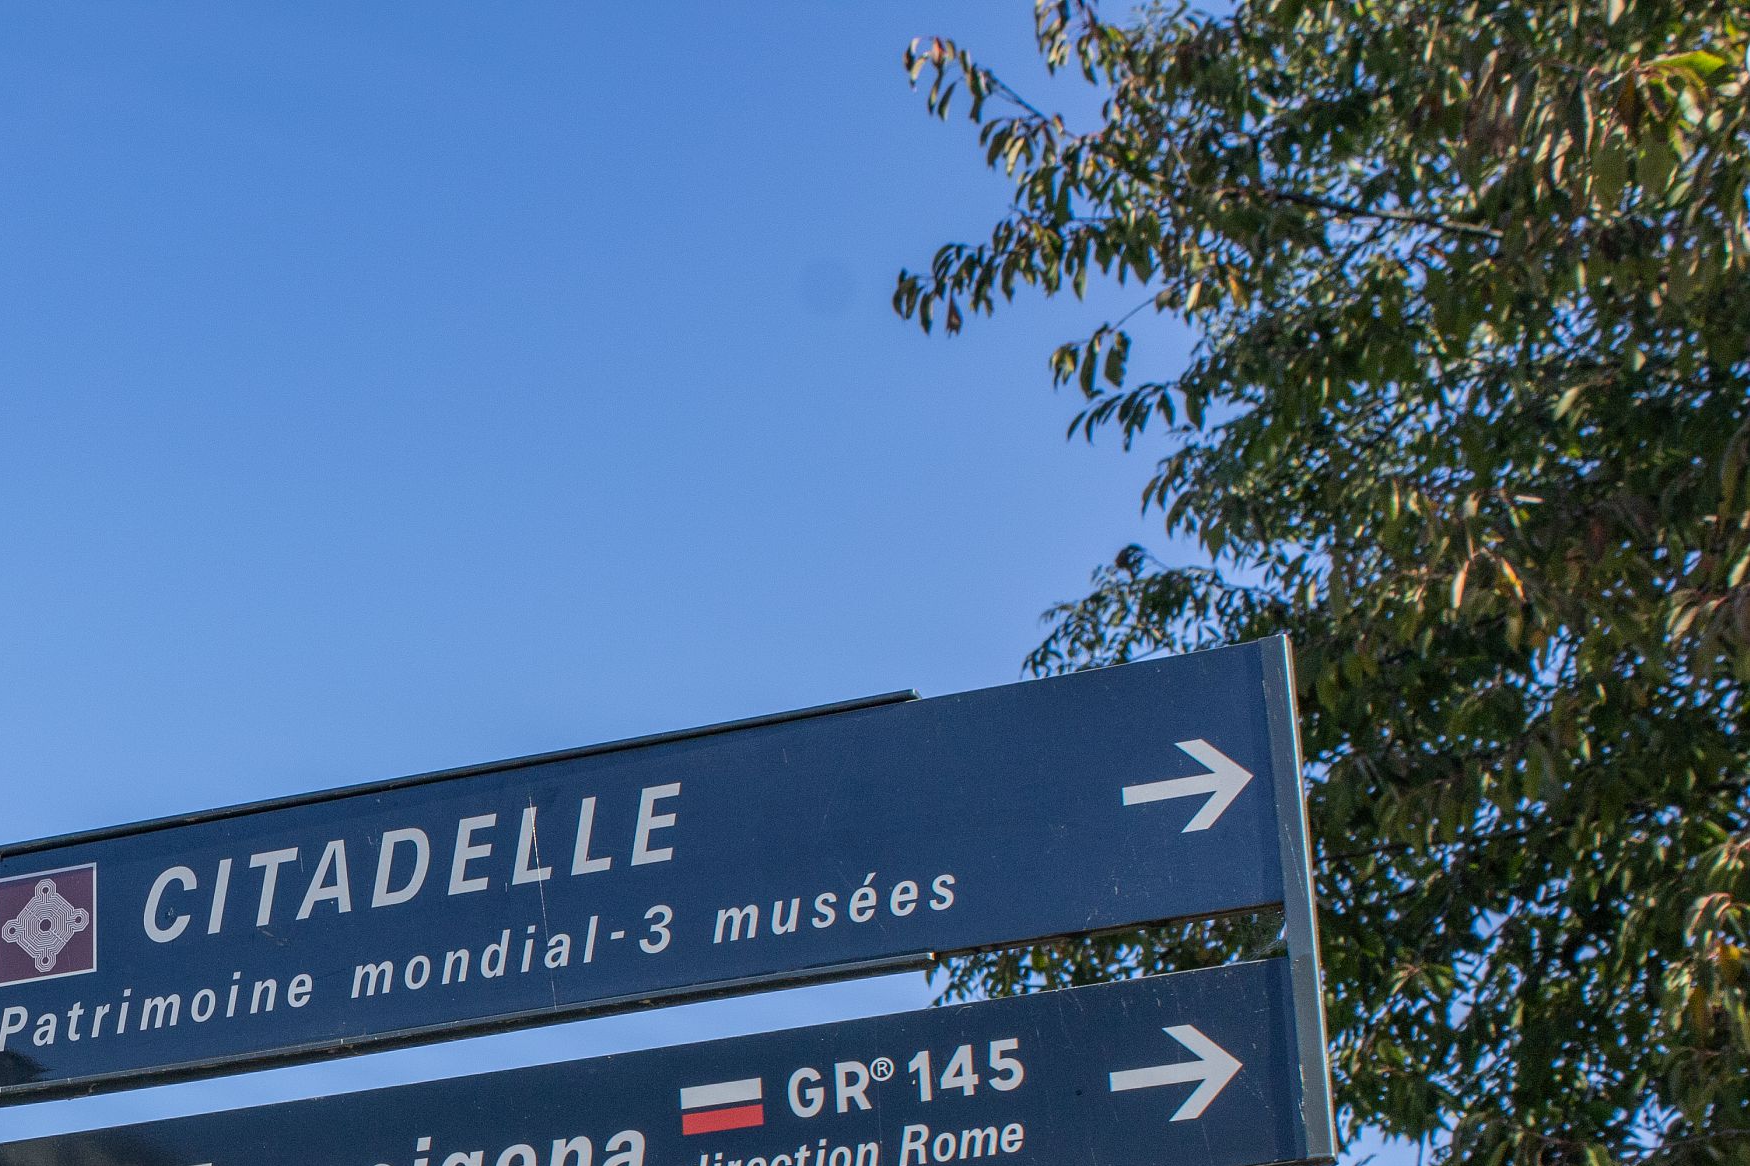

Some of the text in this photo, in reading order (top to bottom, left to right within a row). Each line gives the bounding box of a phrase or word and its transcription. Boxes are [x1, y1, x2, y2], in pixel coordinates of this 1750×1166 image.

[144, 783, 681, 943] CITADELLE
[351, 905, 672, 998] mondial-3
[714, 872, 955, 943] musées
[909, 1038, 1023, 1101] 145
[900, 1123, 1023, 1166] Rome
